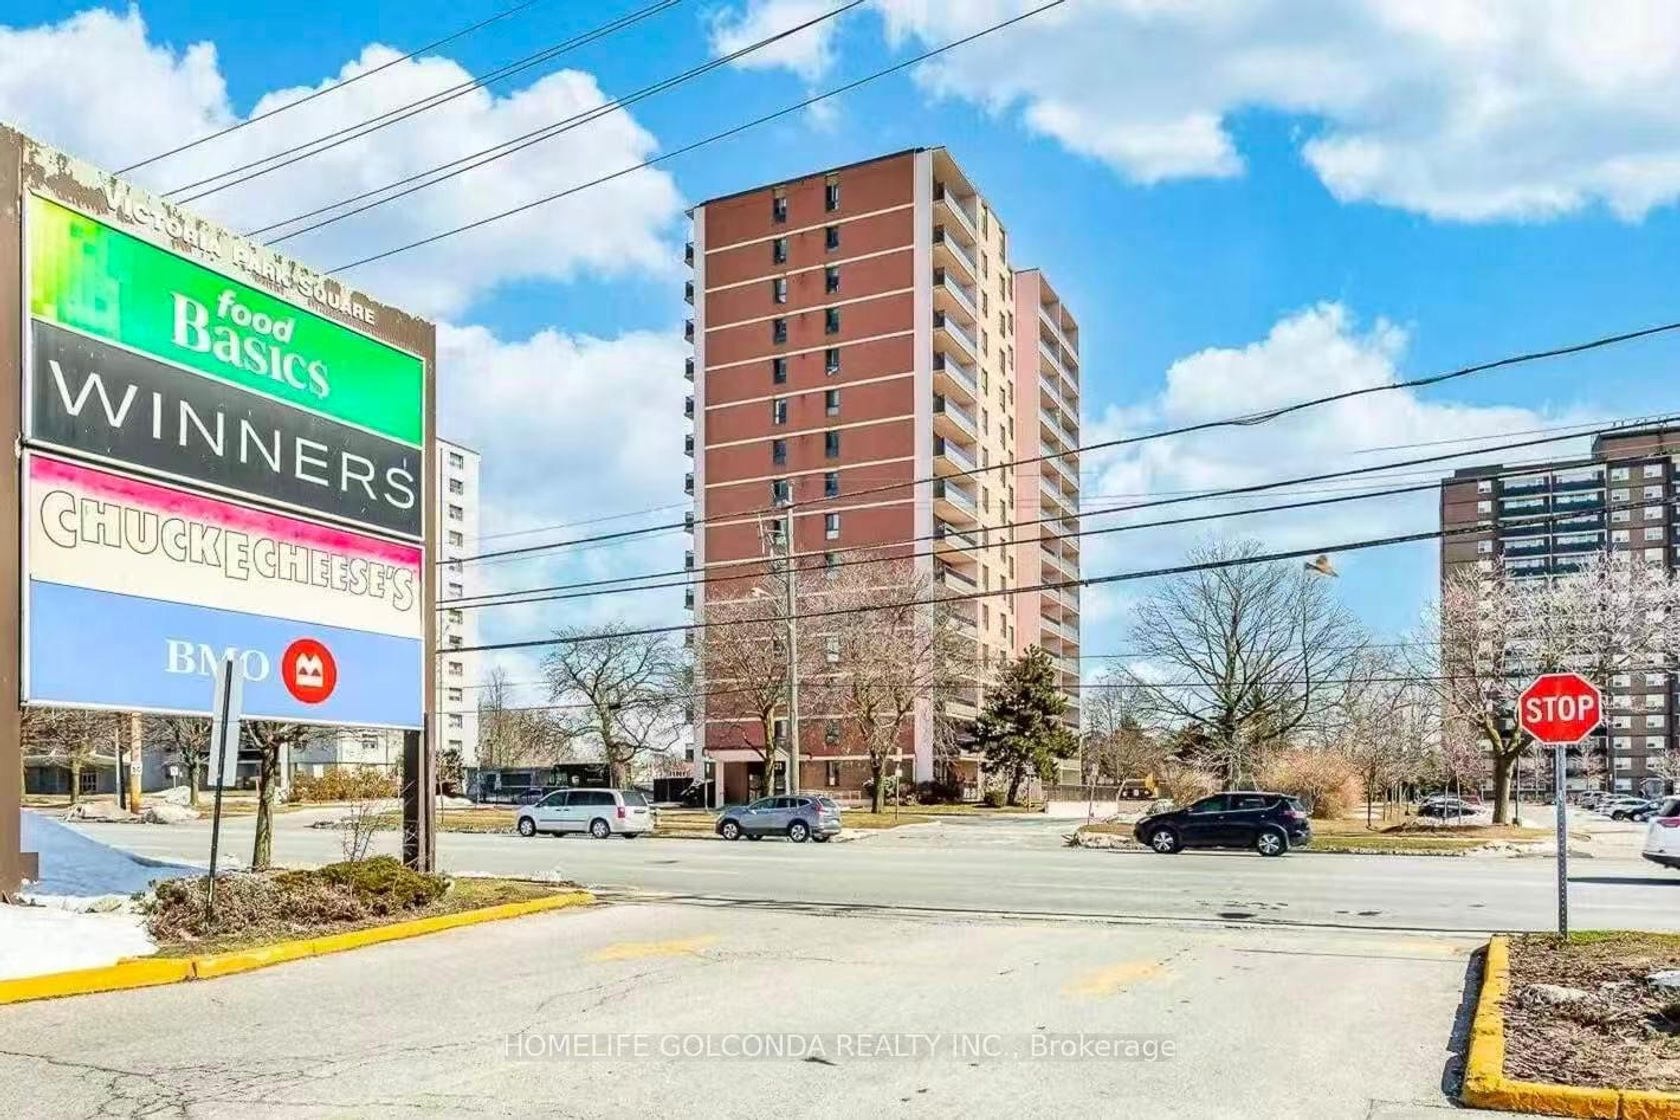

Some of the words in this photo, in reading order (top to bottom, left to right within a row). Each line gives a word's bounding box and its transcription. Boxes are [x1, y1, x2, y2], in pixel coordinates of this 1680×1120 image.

[232, 244, 294, 289] PARK
[297, 271, 376, 326] SQUARE
[217, 289, 295, 344] food
[49, 359, 416, 509] WINNERS
[164, 637, 270, 682] BMO
[1526, 694, 1594, 723] STOP
